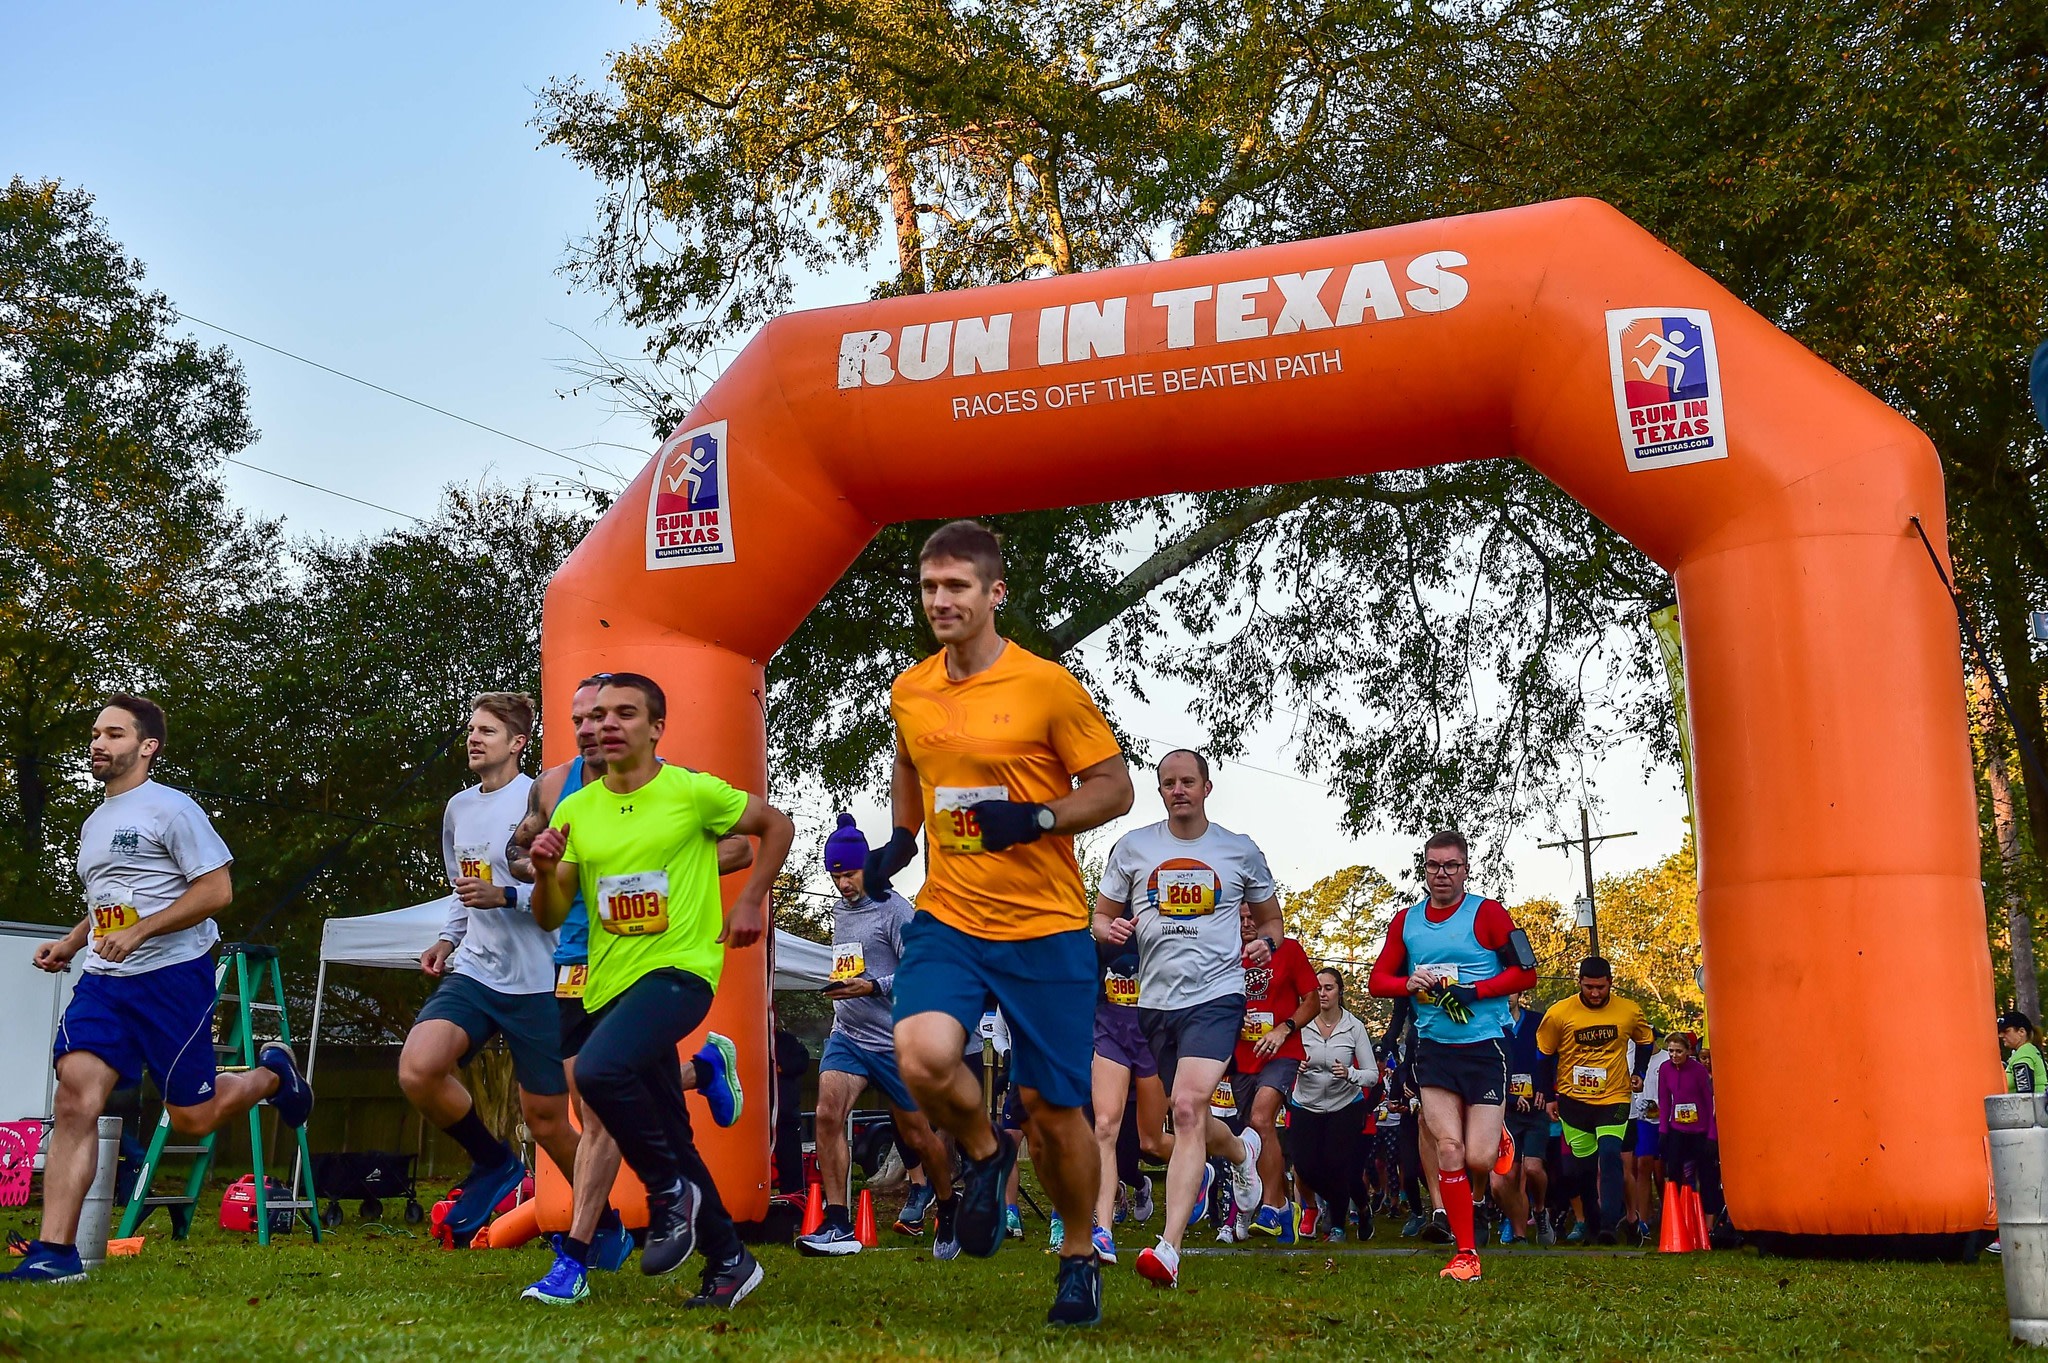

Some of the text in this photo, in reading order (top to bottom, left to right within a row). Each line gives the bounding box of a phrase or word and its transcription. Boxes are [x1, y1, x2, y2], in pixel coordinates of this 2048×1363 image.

[838, 250, 1470, 389] RUN IN TEXAS
[953, 350, 1343, 419] RACES OFF THE BEATEN PATH
[1629, 400, 1708, 427] RUN IN
[1632, 419, 1710, 445] TEXAS
[1638, 438, 1709, 456] RUNINTEXAS.COM
[656, 511, 719, 531] RUN IN
[656, 528, 720, 547] TEXAS
[658, 545, 719, 557] RUNINTEXAS.COM
[460, 861, 481, 878] 275
[1170, 885, 1202, 904] 268
[608, 892, 660, 921] 1003
[95, 905, 125, 929] 279
[837, 956, 856, 973] 241
[1112, 979, 1136, 995] 388
[1579, 1028, 1614, 1041] BACK PEW
[1580, 1075, 1599, 1088] 356
[1216, 1089, 1230, 1101] 310
